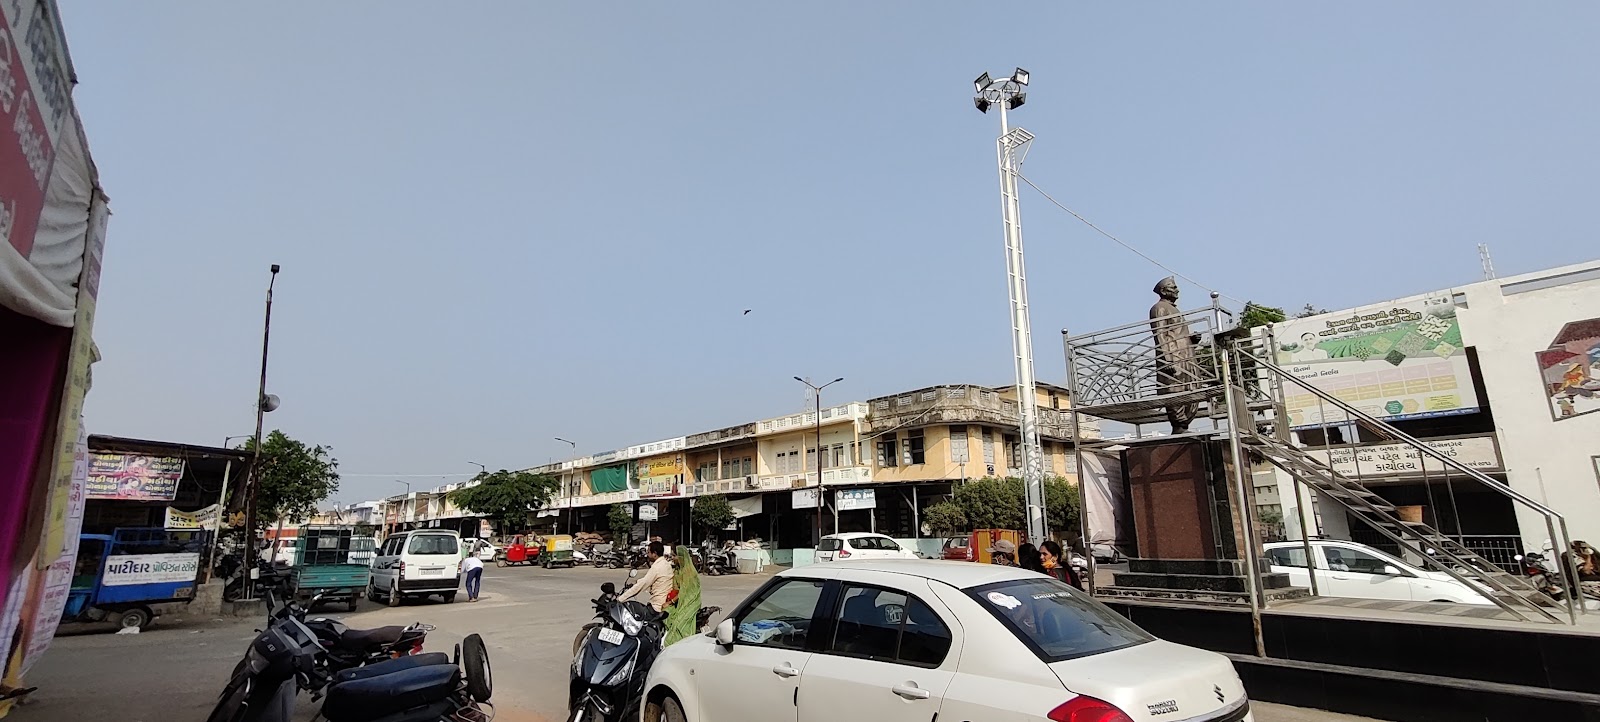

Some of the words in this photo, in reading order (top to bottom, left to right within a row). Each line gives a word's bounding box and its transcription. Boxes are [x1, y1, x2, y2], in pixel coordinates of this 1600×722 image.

[1378, 450, 1400, 463] પટેલ
[1376, 460, 1417, 472] કાર્યાલય
[108, 560, 150, 574] પાટીદાર
[1150, 706, 1178, 716] SUZUKI
